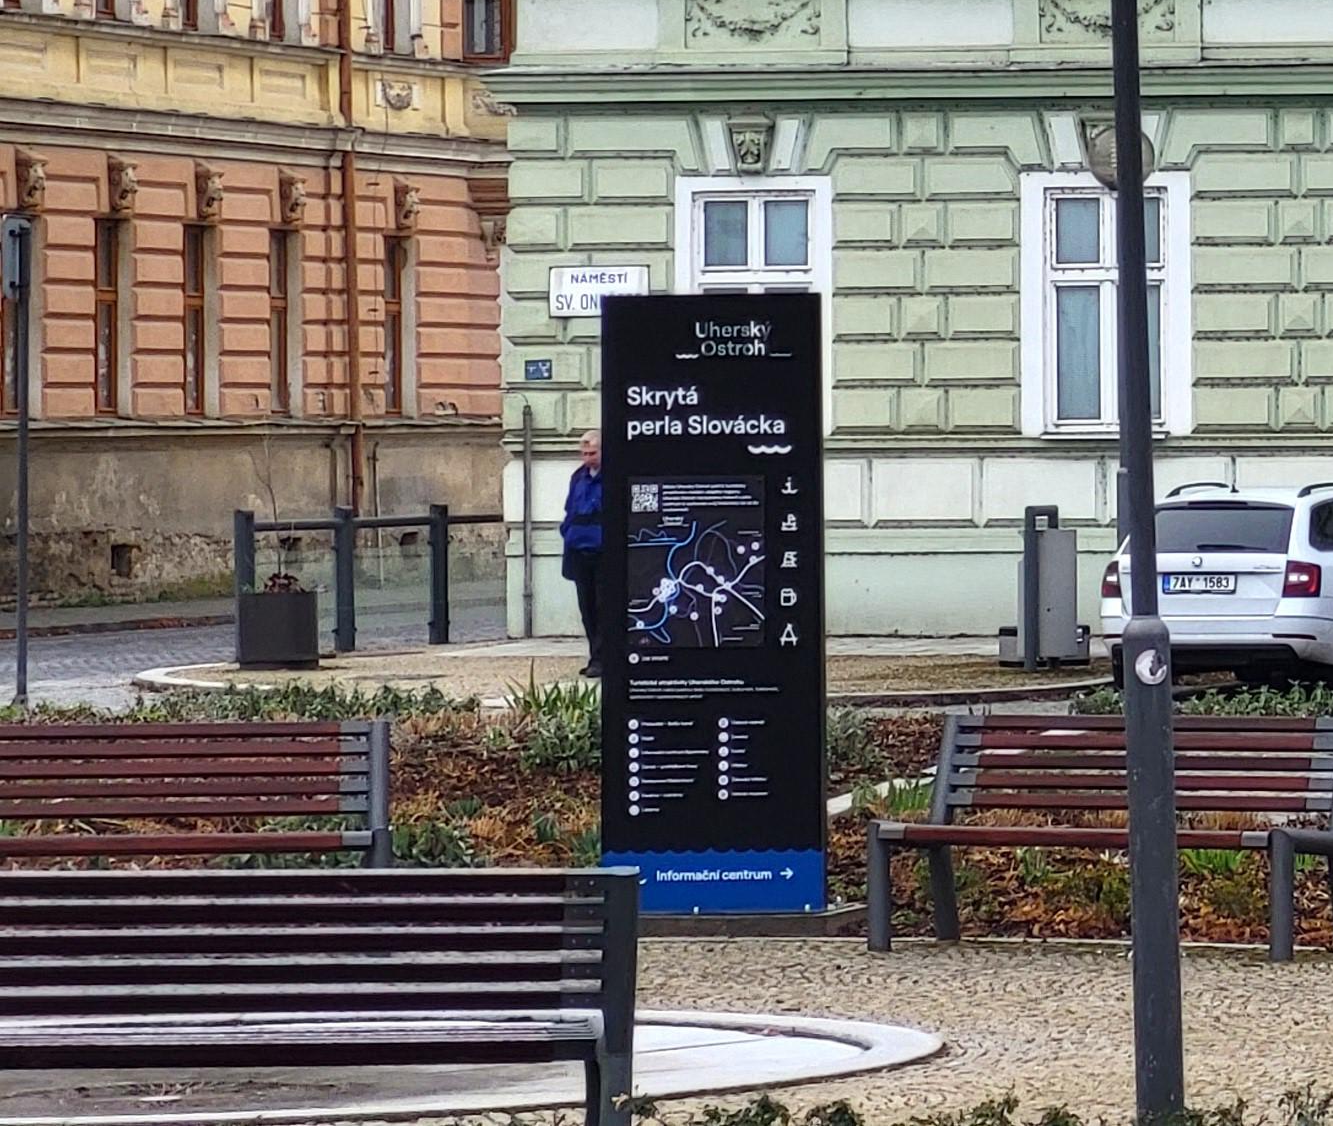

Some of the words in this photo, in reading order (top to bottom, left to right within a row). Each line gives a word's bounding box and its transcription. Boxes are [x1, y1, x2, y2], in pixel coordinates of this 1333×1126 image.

[570, 271, 628, 285] NÁMĚSTÍ
[555, 293, 576, 311] SV.
[694, 320, 772, 341] Uherský
[700, 338, 766, 357] Ostroh
[626, 385, 699, 411] Skrytá
[626, 415, 683, 441] perla
[687, 414, 786, 435] Slovácka
[1172, 575, 1194, 589] 7AY
[1202, 575, 1230, 589] 1583
[656, 869, 721, 882] Informační
[721, 870, 773, 881] centrum
